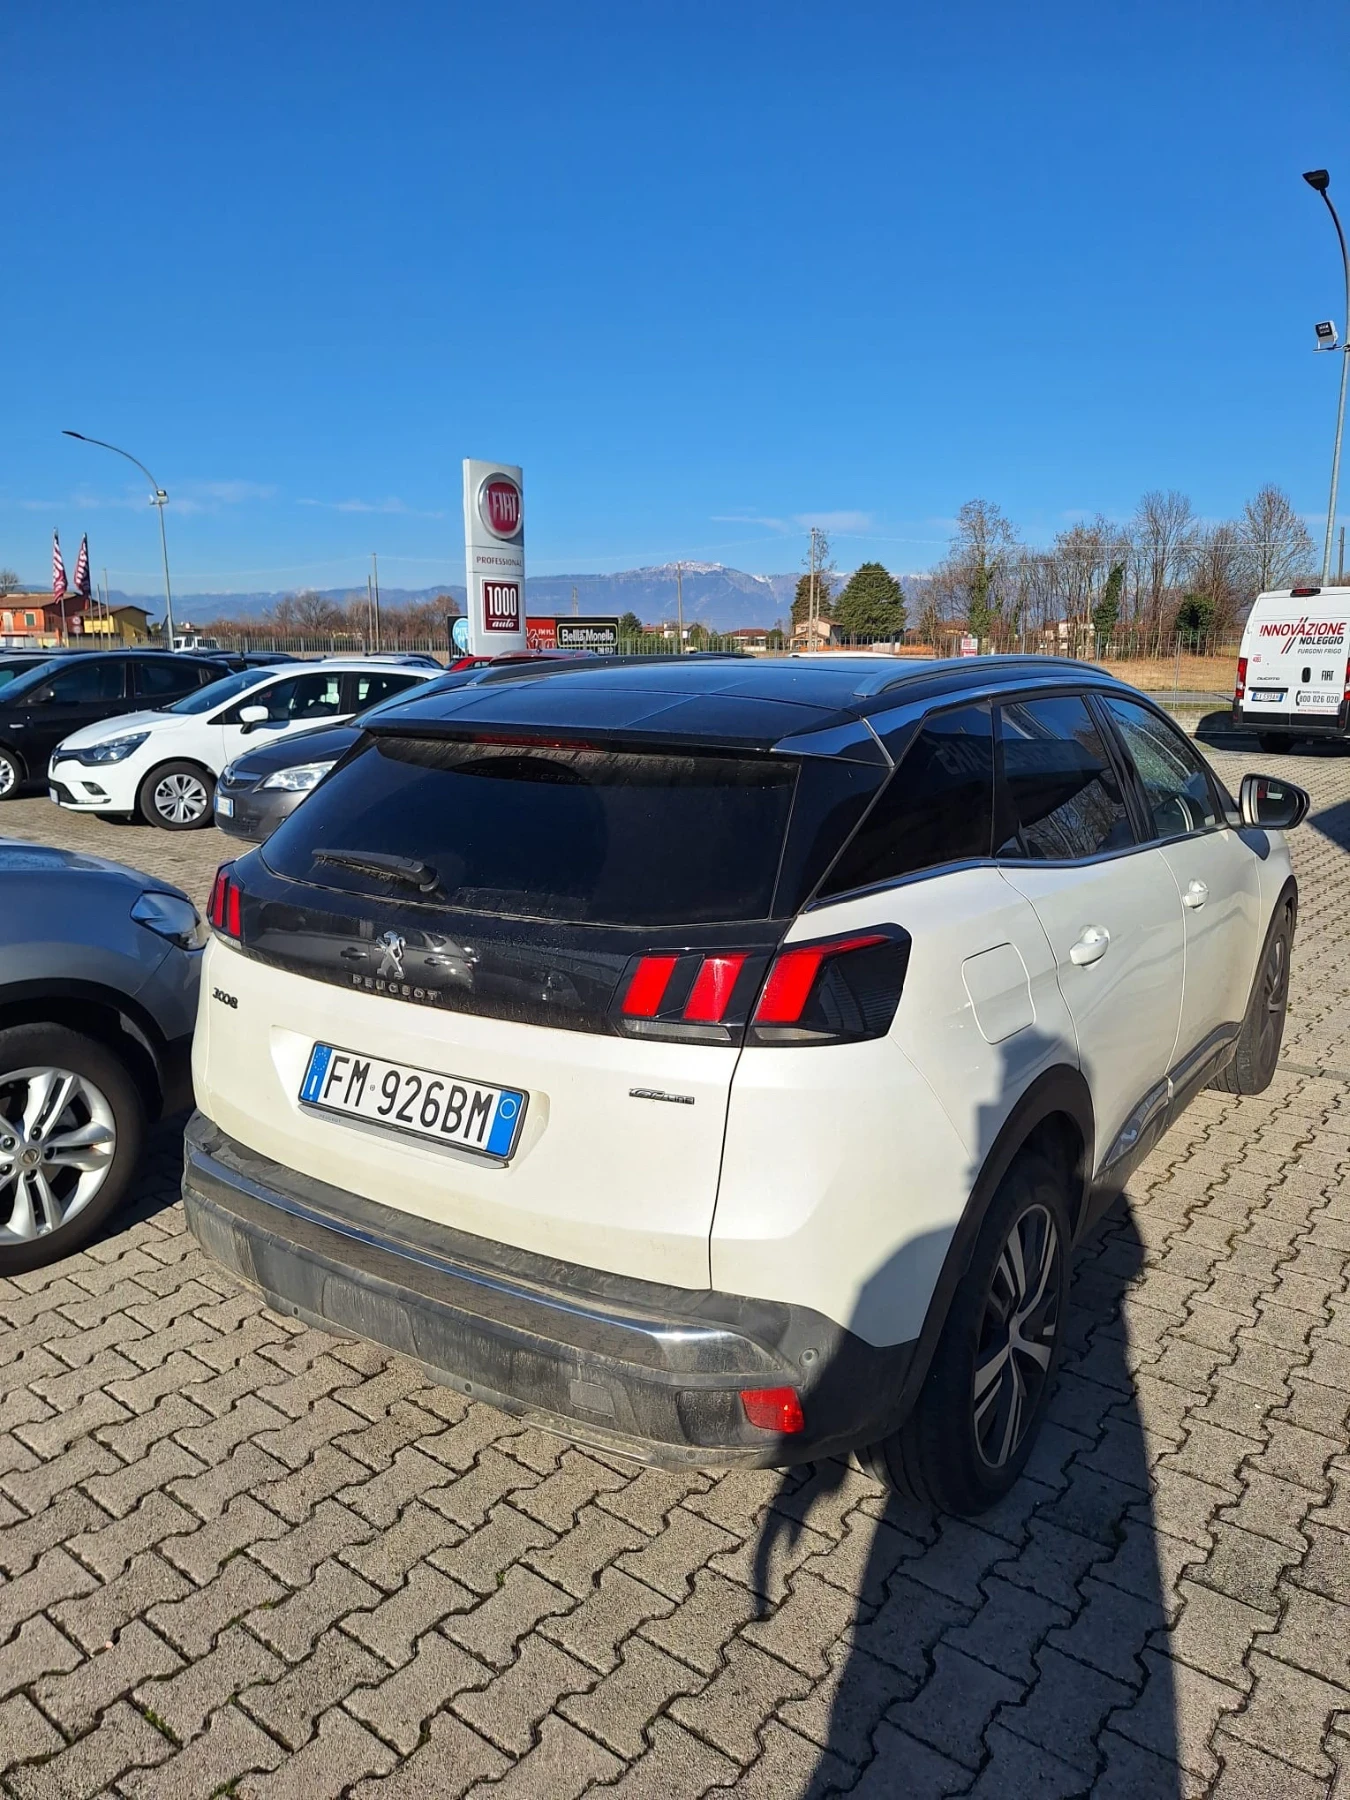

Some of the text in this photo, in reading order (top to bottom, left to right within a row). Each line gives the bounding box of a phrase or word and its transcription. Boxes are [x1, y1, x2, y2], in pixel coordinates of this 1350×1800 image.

[492, 491, 517, 522] FIAT
[476, 556, 522, 567] PROFESSIONAL
[487, 586, 517, 616] 1000
[492, 619, 515, 628] auto
[1259, 622, 1347, 637] INNOVAZIONE
[1299, 636, 1344, 645] NOLEGGIO
[1321, 670, 1334, 681] FIAT
[1312, 695, 1325, 703] 026
[1326, 695, 1339, 704] 020
[352, 973, 438, 1001] PEUGEOT
[212, 986, 238, 1009] 3008
[323, 1055, 494, 1142] FM 926BM
